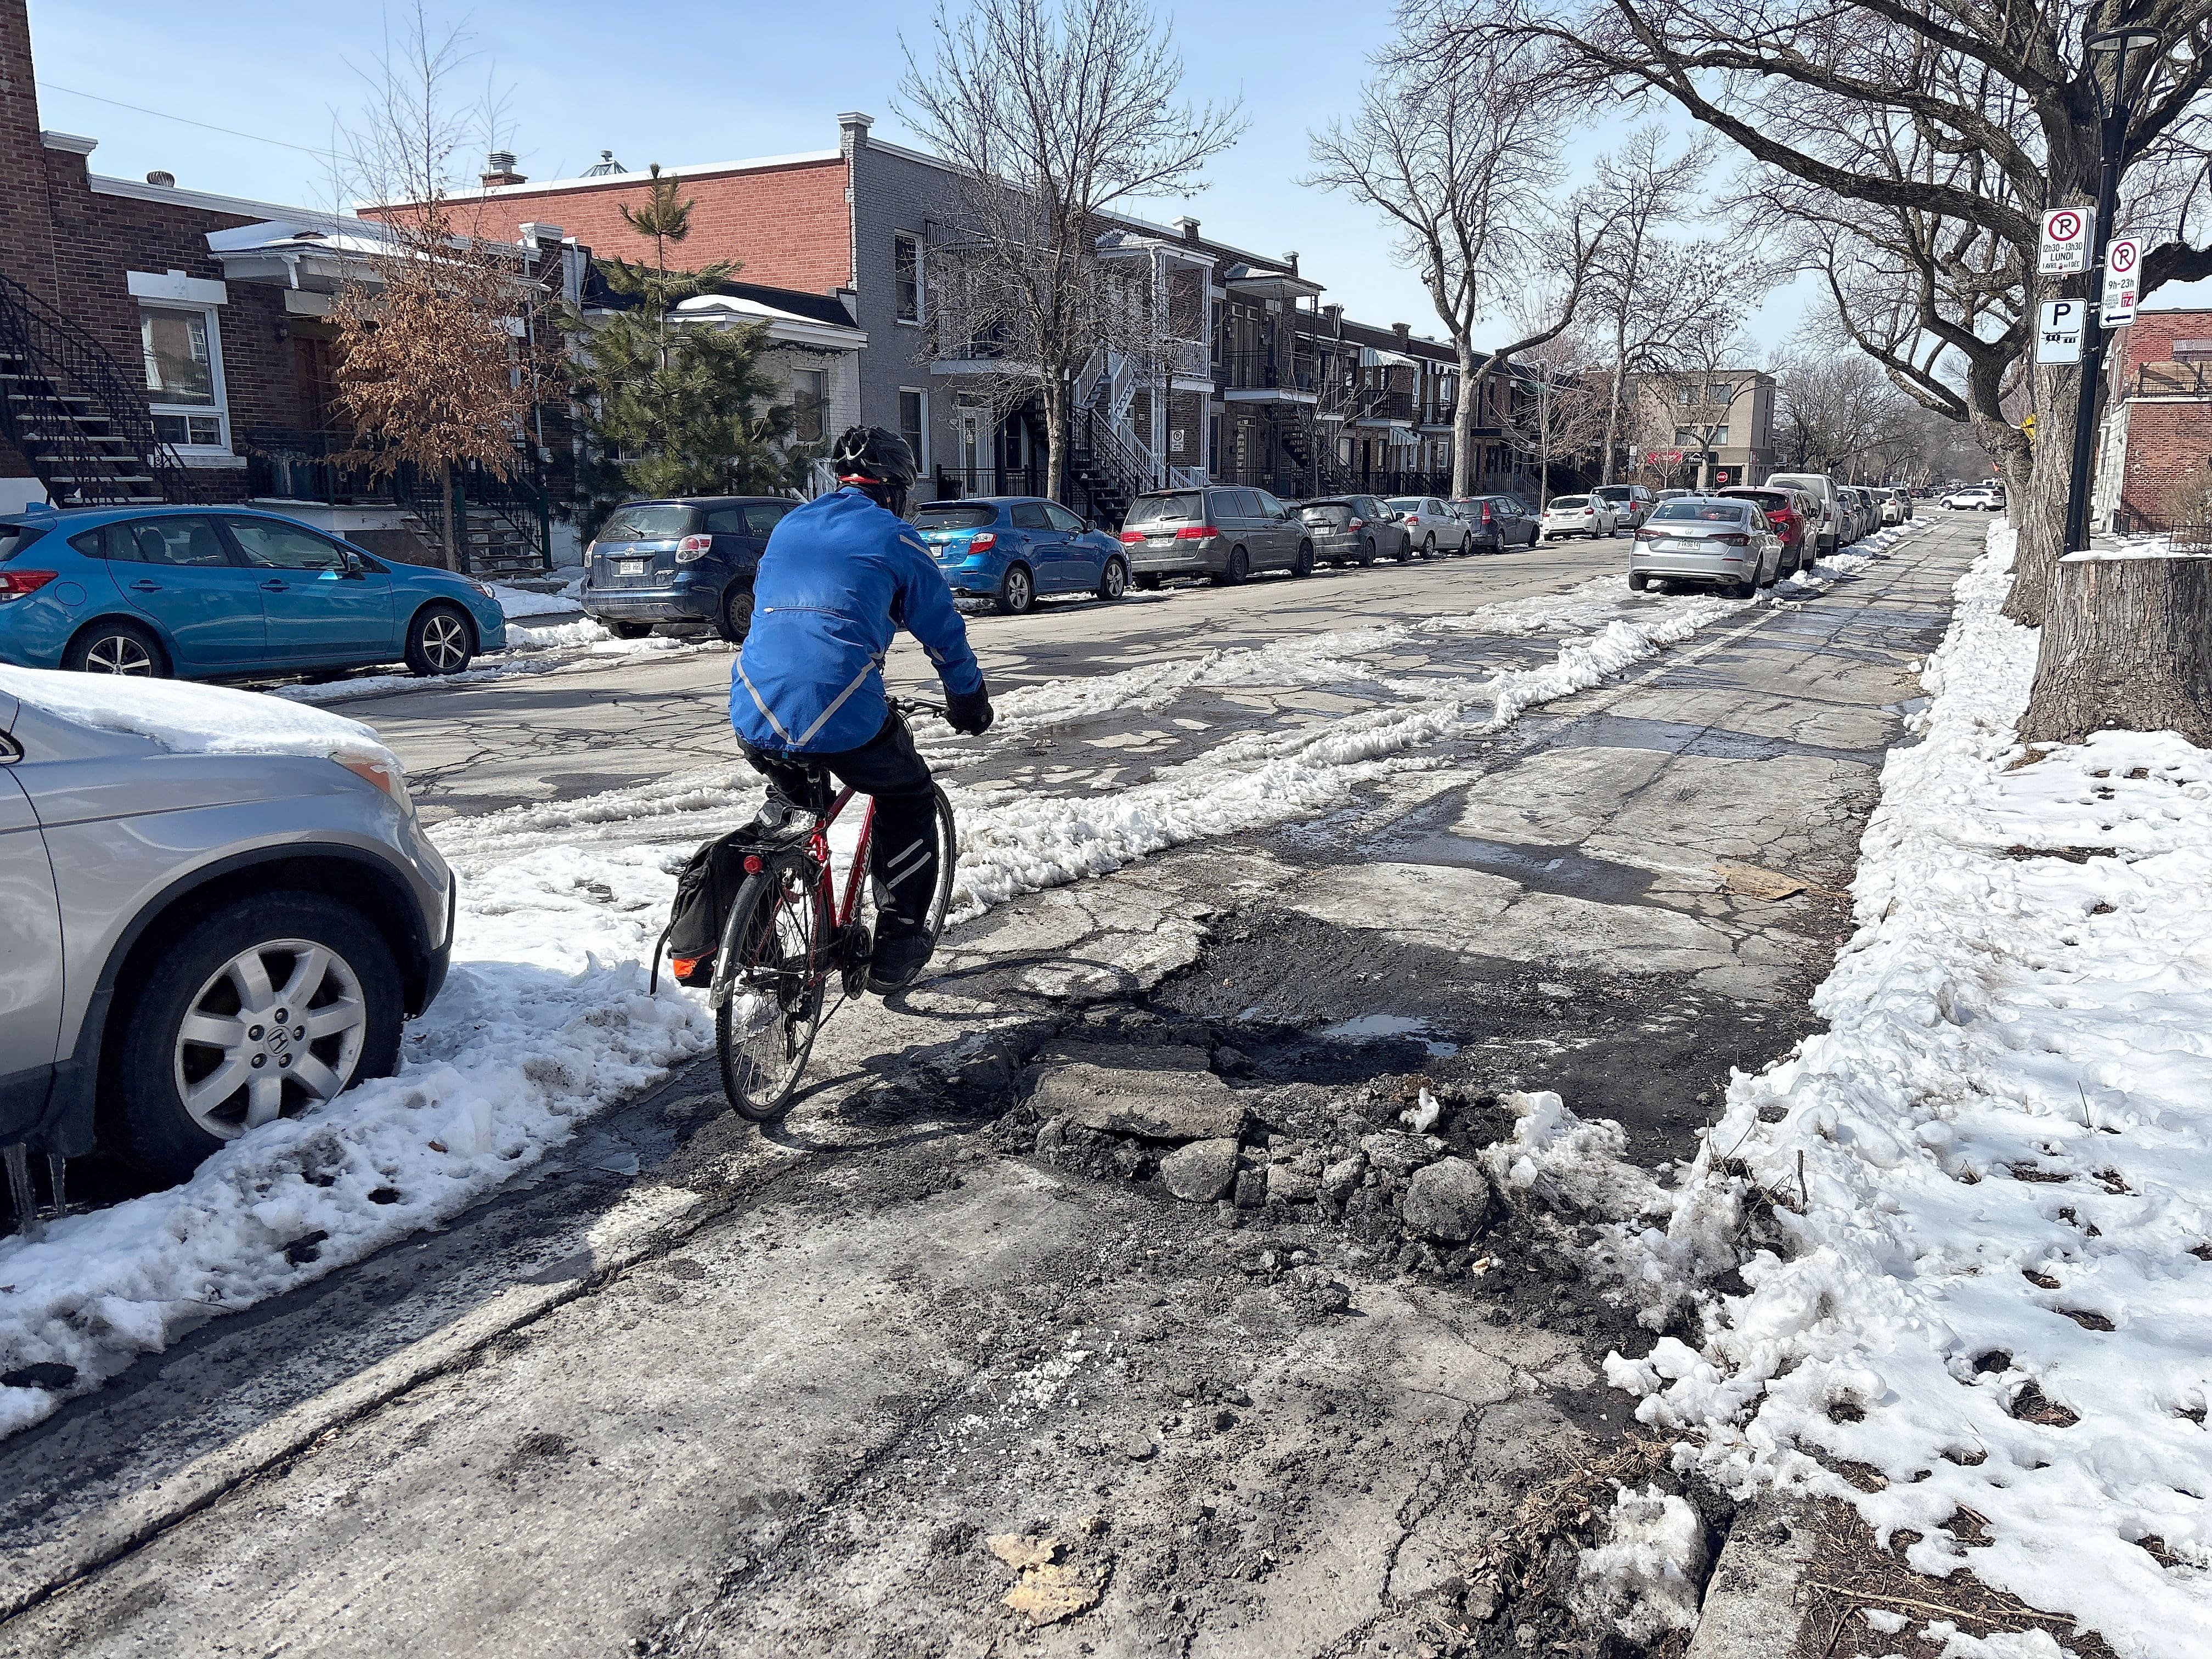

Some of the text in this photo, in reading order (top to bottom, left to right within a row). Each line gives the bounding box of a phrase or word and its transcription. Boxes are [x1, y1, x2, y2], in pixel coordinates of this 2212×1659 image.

[2043, 244, 2059, 252] 12h30
[2066, 242, 2083, 251] 13h30
[2050, 252, 2073, 261] LUNDI
[2122, 297, 2133, 307] 174
[2053, 303, 2071, 325] P
